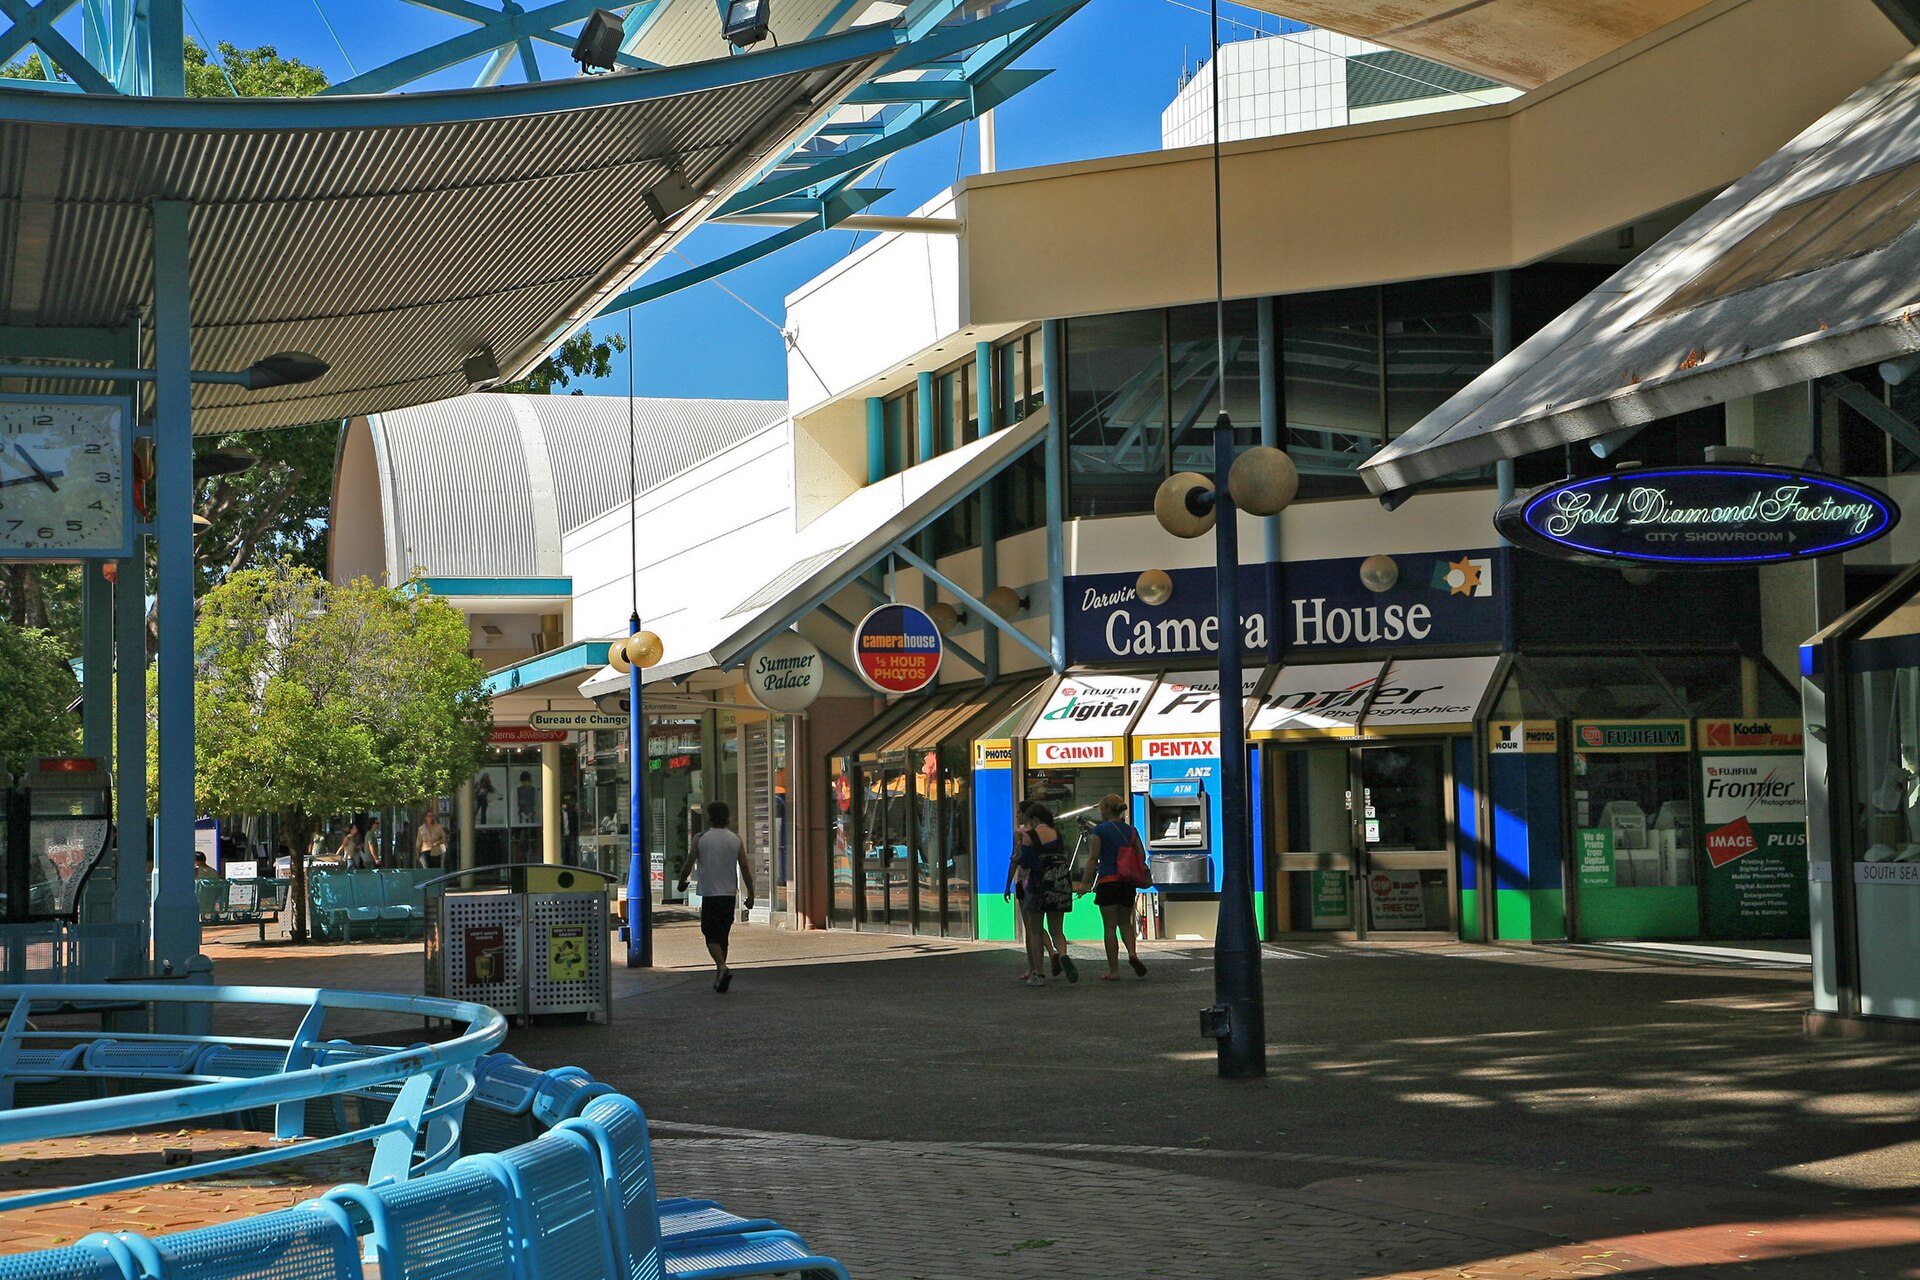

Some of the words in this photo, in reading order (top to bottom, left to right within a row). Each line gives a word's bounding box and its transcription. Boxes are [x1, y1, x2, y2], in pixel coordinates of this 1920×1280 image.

[33, 415, 53, 426] 12
[9, 424, 22, 434] 11
[84, 444, 101, 454] 2
[95, 472, 111, 483] 3
[88, 500, 103, 511] 4
[1548, 490, 1619, 536] Gold
[1627, 487, 1761, 526] Diamond
[1760, 485, 1874, 534] Factory
[7, 520, 24, 530] 7
[66, 520, 82, 531] 5
[37, 527, 54, 538] 6
[1645, 531, 1681, 542] CITY
[1684, 531, 1784, 542] SHOWROOM
[1082, 586, 1137, 612] Darwin
[1105, 609, 1268, 656] Camea
[1291, 598, 1432, 646] House
[863, 633, 936, 648] camerahouse
[756, 654, 815, 675] Summer
[890, 656, 926, 668] HOUR
[874, 668, 926, 680] PHOTOS
[764, 670, 811, 691] Palace
[1082, 687, 1141, 696] FUJIFILM
[1190, 682, 1257, 691] FUJM
[1043, 697, 1139, 721] digital
[1322, 705, 1471, 718] Phoographics
[535, 715, 572, 724] Bureau
[574, 715, 587, 724] de
[590, 715, 628, 726] Change
[1499, 725, 1512, 741] 1
[1733, 723, 1772, 735] Kodak
[1526, 732, 1555, 742] PHOTOS
[1607, 730, 1680, 744] FUJIFILM
[1770, 734, 1803, 746] FILM
[986, 750, 1012, 759] PHOTOS
[1046, 745, 1104, 760] Canon
[1149, 741, 1213, 757] PENTAX
[1185, 767, 1212, 777] ANZ
[1718, 767, 1757, 776] FUJIFILM
[1173, 785, 1192, 794] ATM
[1710, 836, 1753, 847] IMAGE
[1767, 834, 1805, 847] PLUS
[1863, 866, 1896, 880] SOUTH
[1900, 866, 1918, 880] SEA
